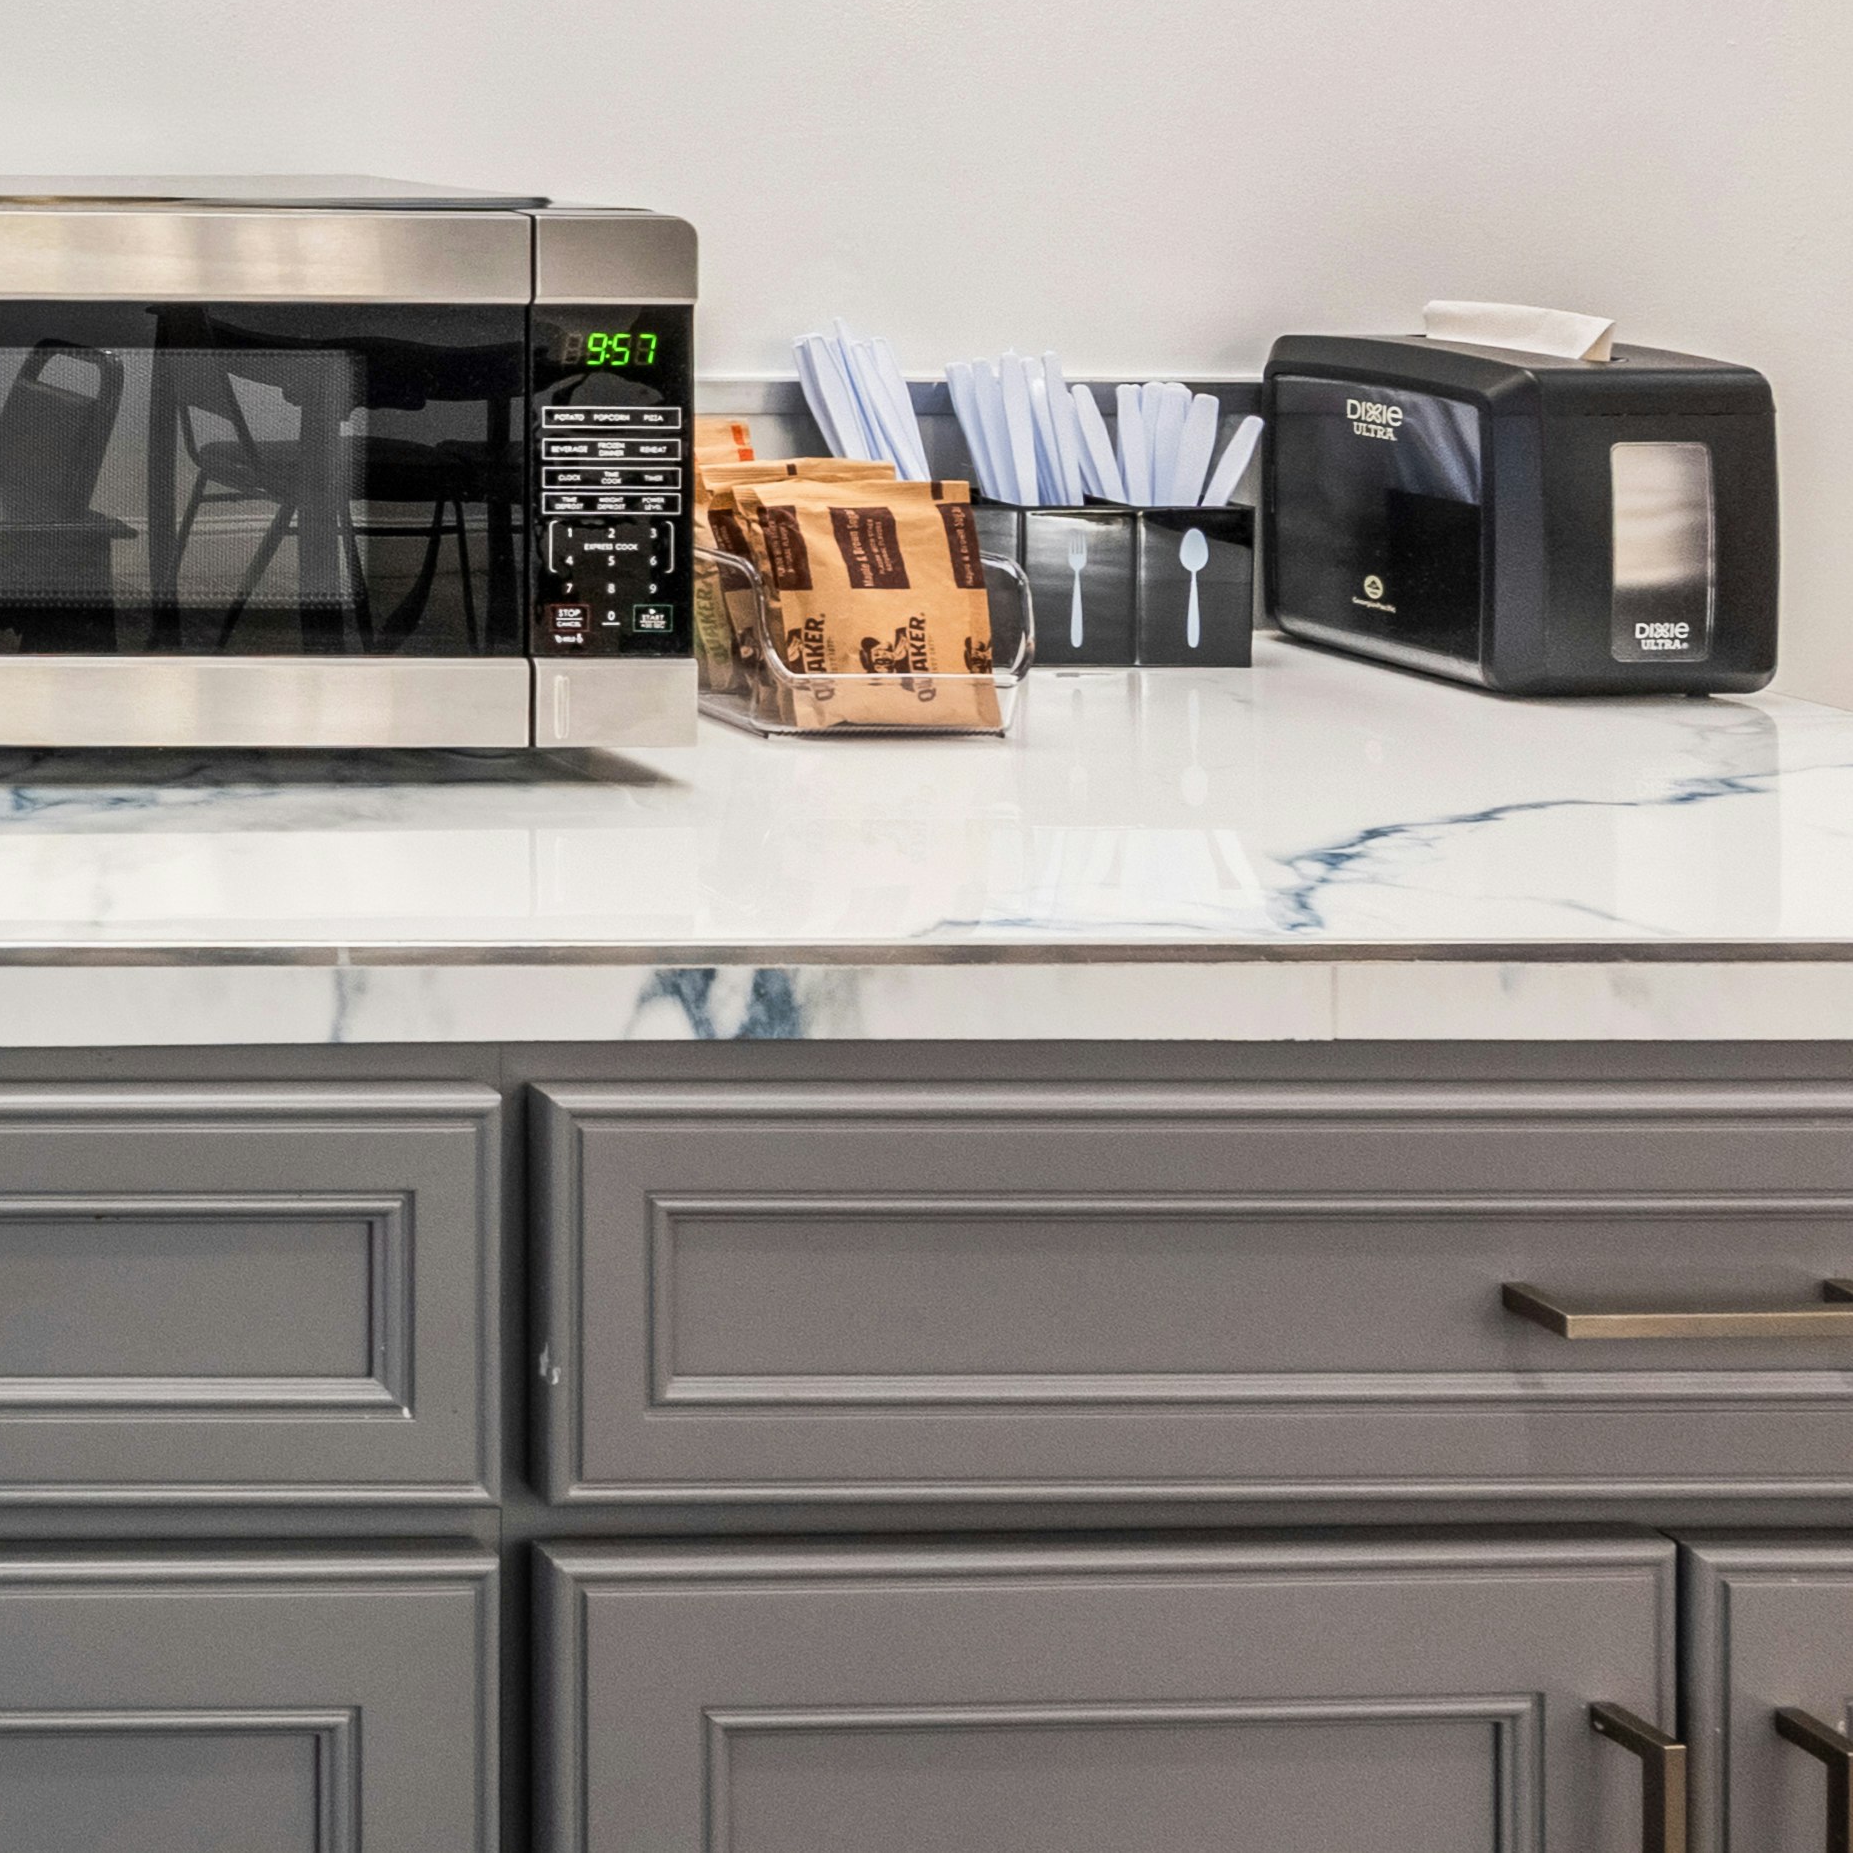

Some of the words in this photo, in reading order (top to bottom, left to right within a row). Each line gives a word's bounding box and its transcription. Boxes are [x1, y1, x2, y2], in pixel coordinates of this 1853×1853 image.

[587, 332, 657, 366] 9:57
[553, 413, 585, 421] POTATO
[594, 413, 630, 421] POPCORN
[643, 413, 664, 421] PIZZA
[1353, 421, 1398, 441] ULTRA
[551, 445, 588, 453] BEVERAGE
[558, 473, 581, 481] CLOCK
[567, 527, 573, 538] 1
[607, 528, 616, 539] 2
[650, 528, 658, 539] 3
[583, 543, 614, 551] EXPRESS
[615, 543, 639, 551] COOK
[850, 530, 865, 555] Brown
[565, 555, 574, 566] 4
[607, 555, 616, 567] 5
[649, 555, 658, 566] 6
[565, 582, 573, 594] 7
[607, 582, 616, 594] 8
[649, 583, 657, 594] 9
[558, 608, 582, 617] STOP
[607, 610, 616, 621] 0
